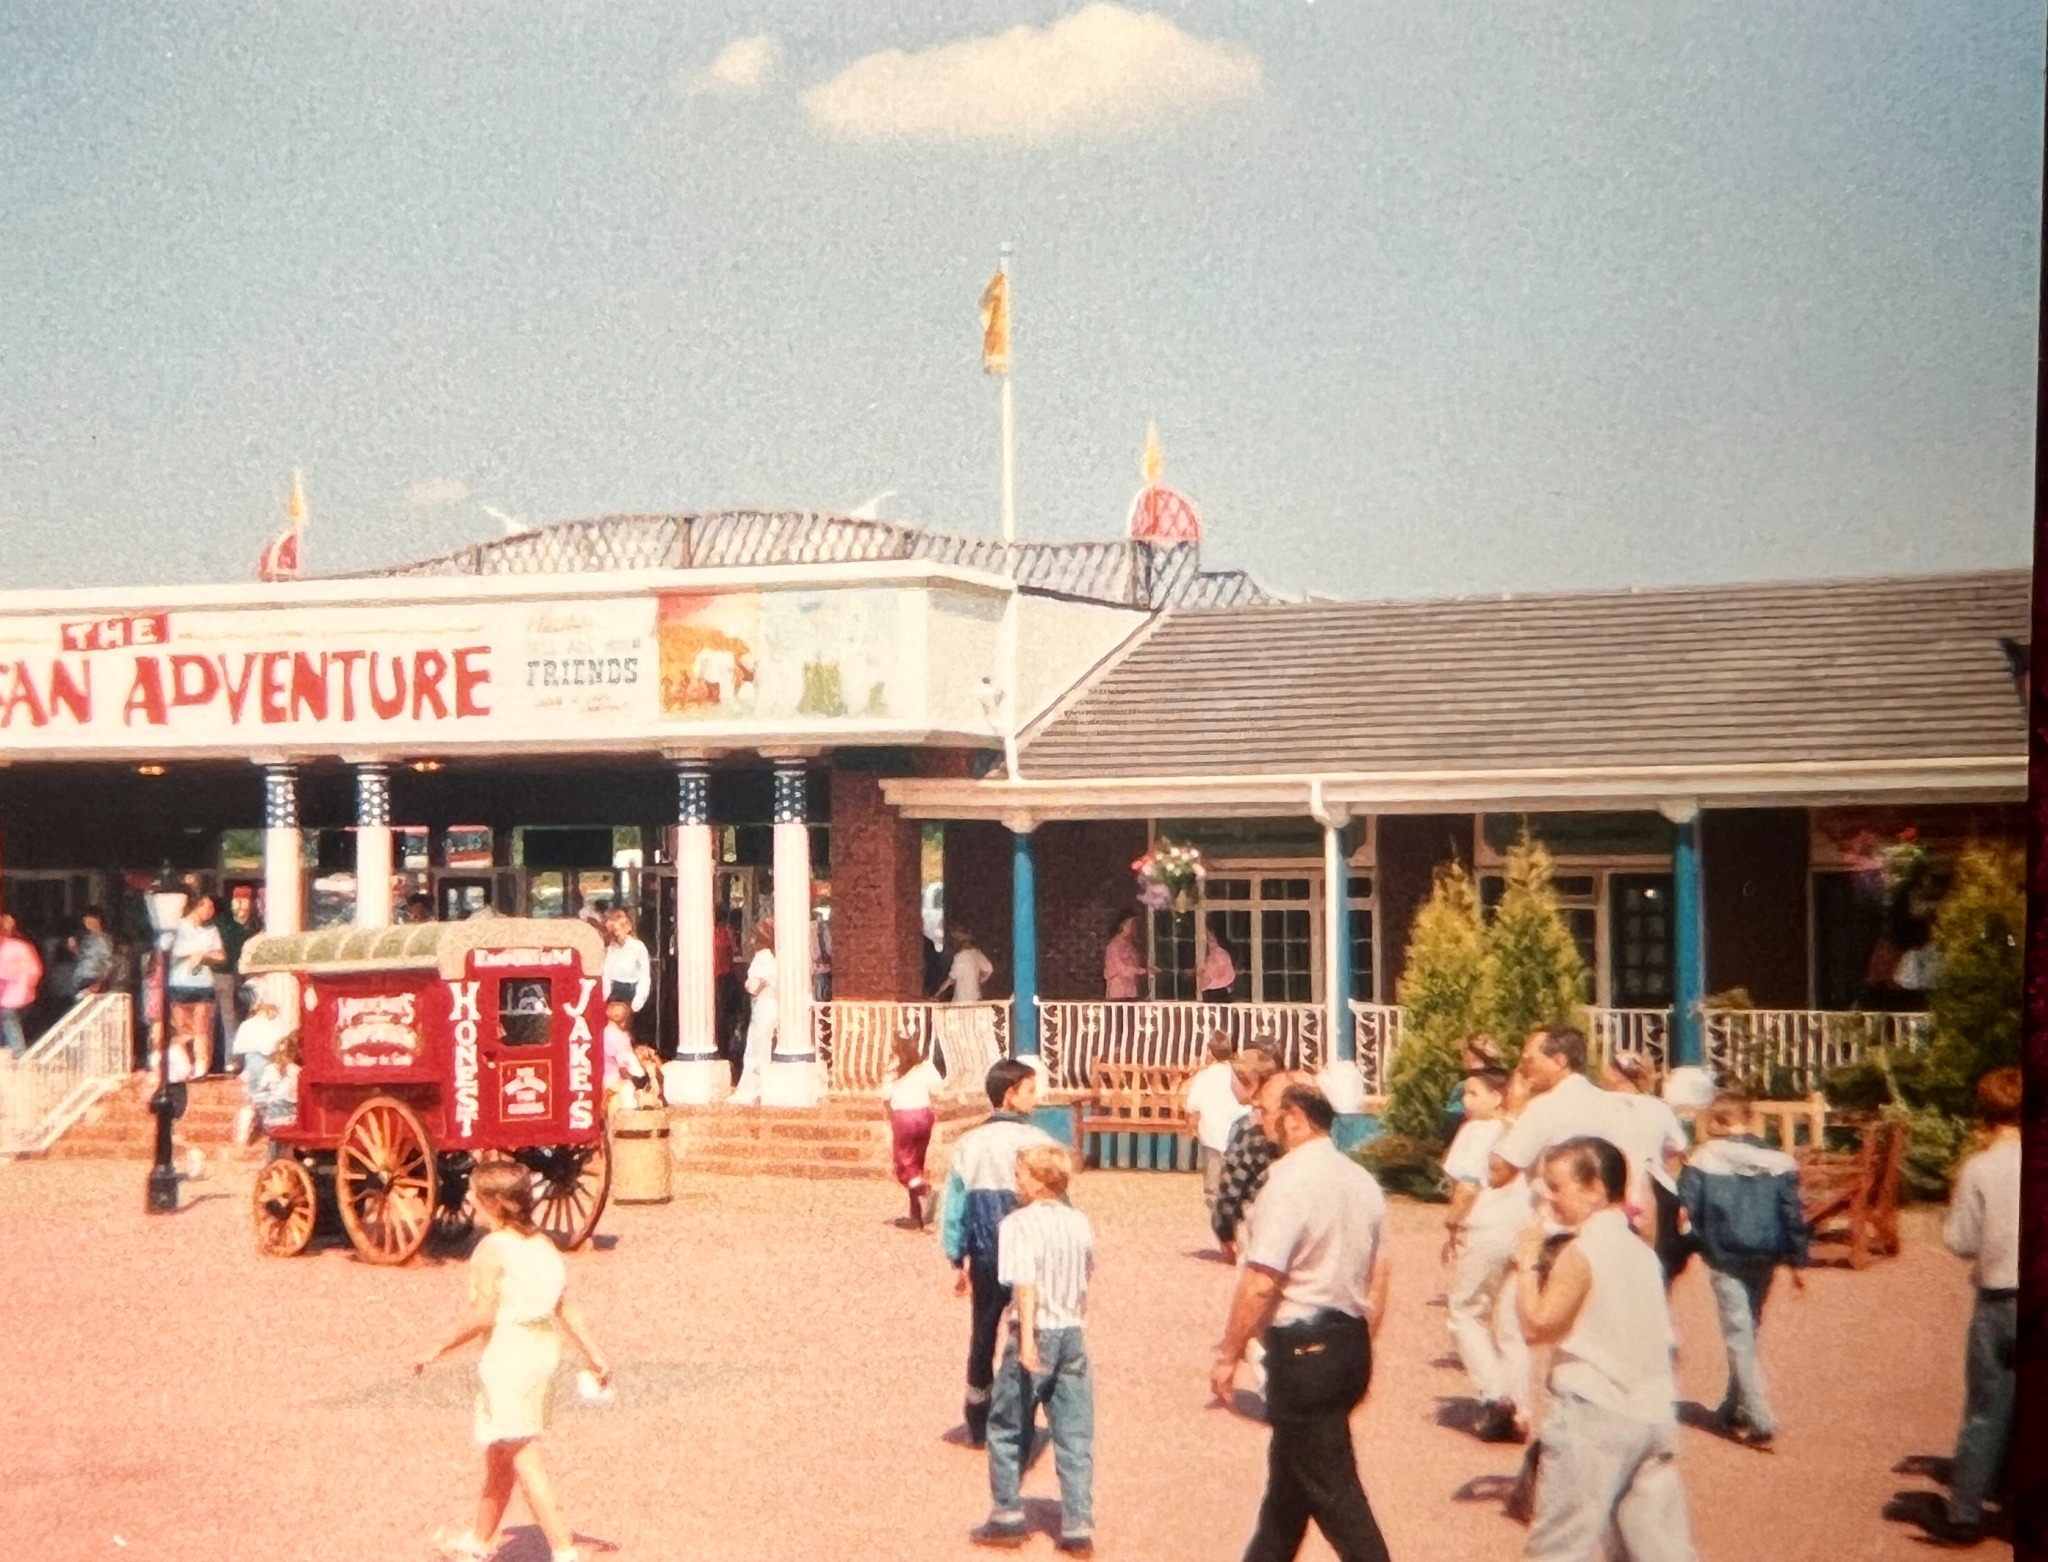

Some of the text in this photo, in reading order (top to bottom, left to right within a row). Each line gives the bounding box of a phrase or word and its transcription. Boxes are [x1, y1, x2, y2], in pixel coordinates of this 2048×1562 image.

[67, 617, 158, 649] THE
[526, 657, 638, 687] FRIENDS
[0, 646, 492, 728] AN ADVENTURE
[449, 981, 481, 1138] HONEST
[563, 977, 597, 1130] JAKE'S
